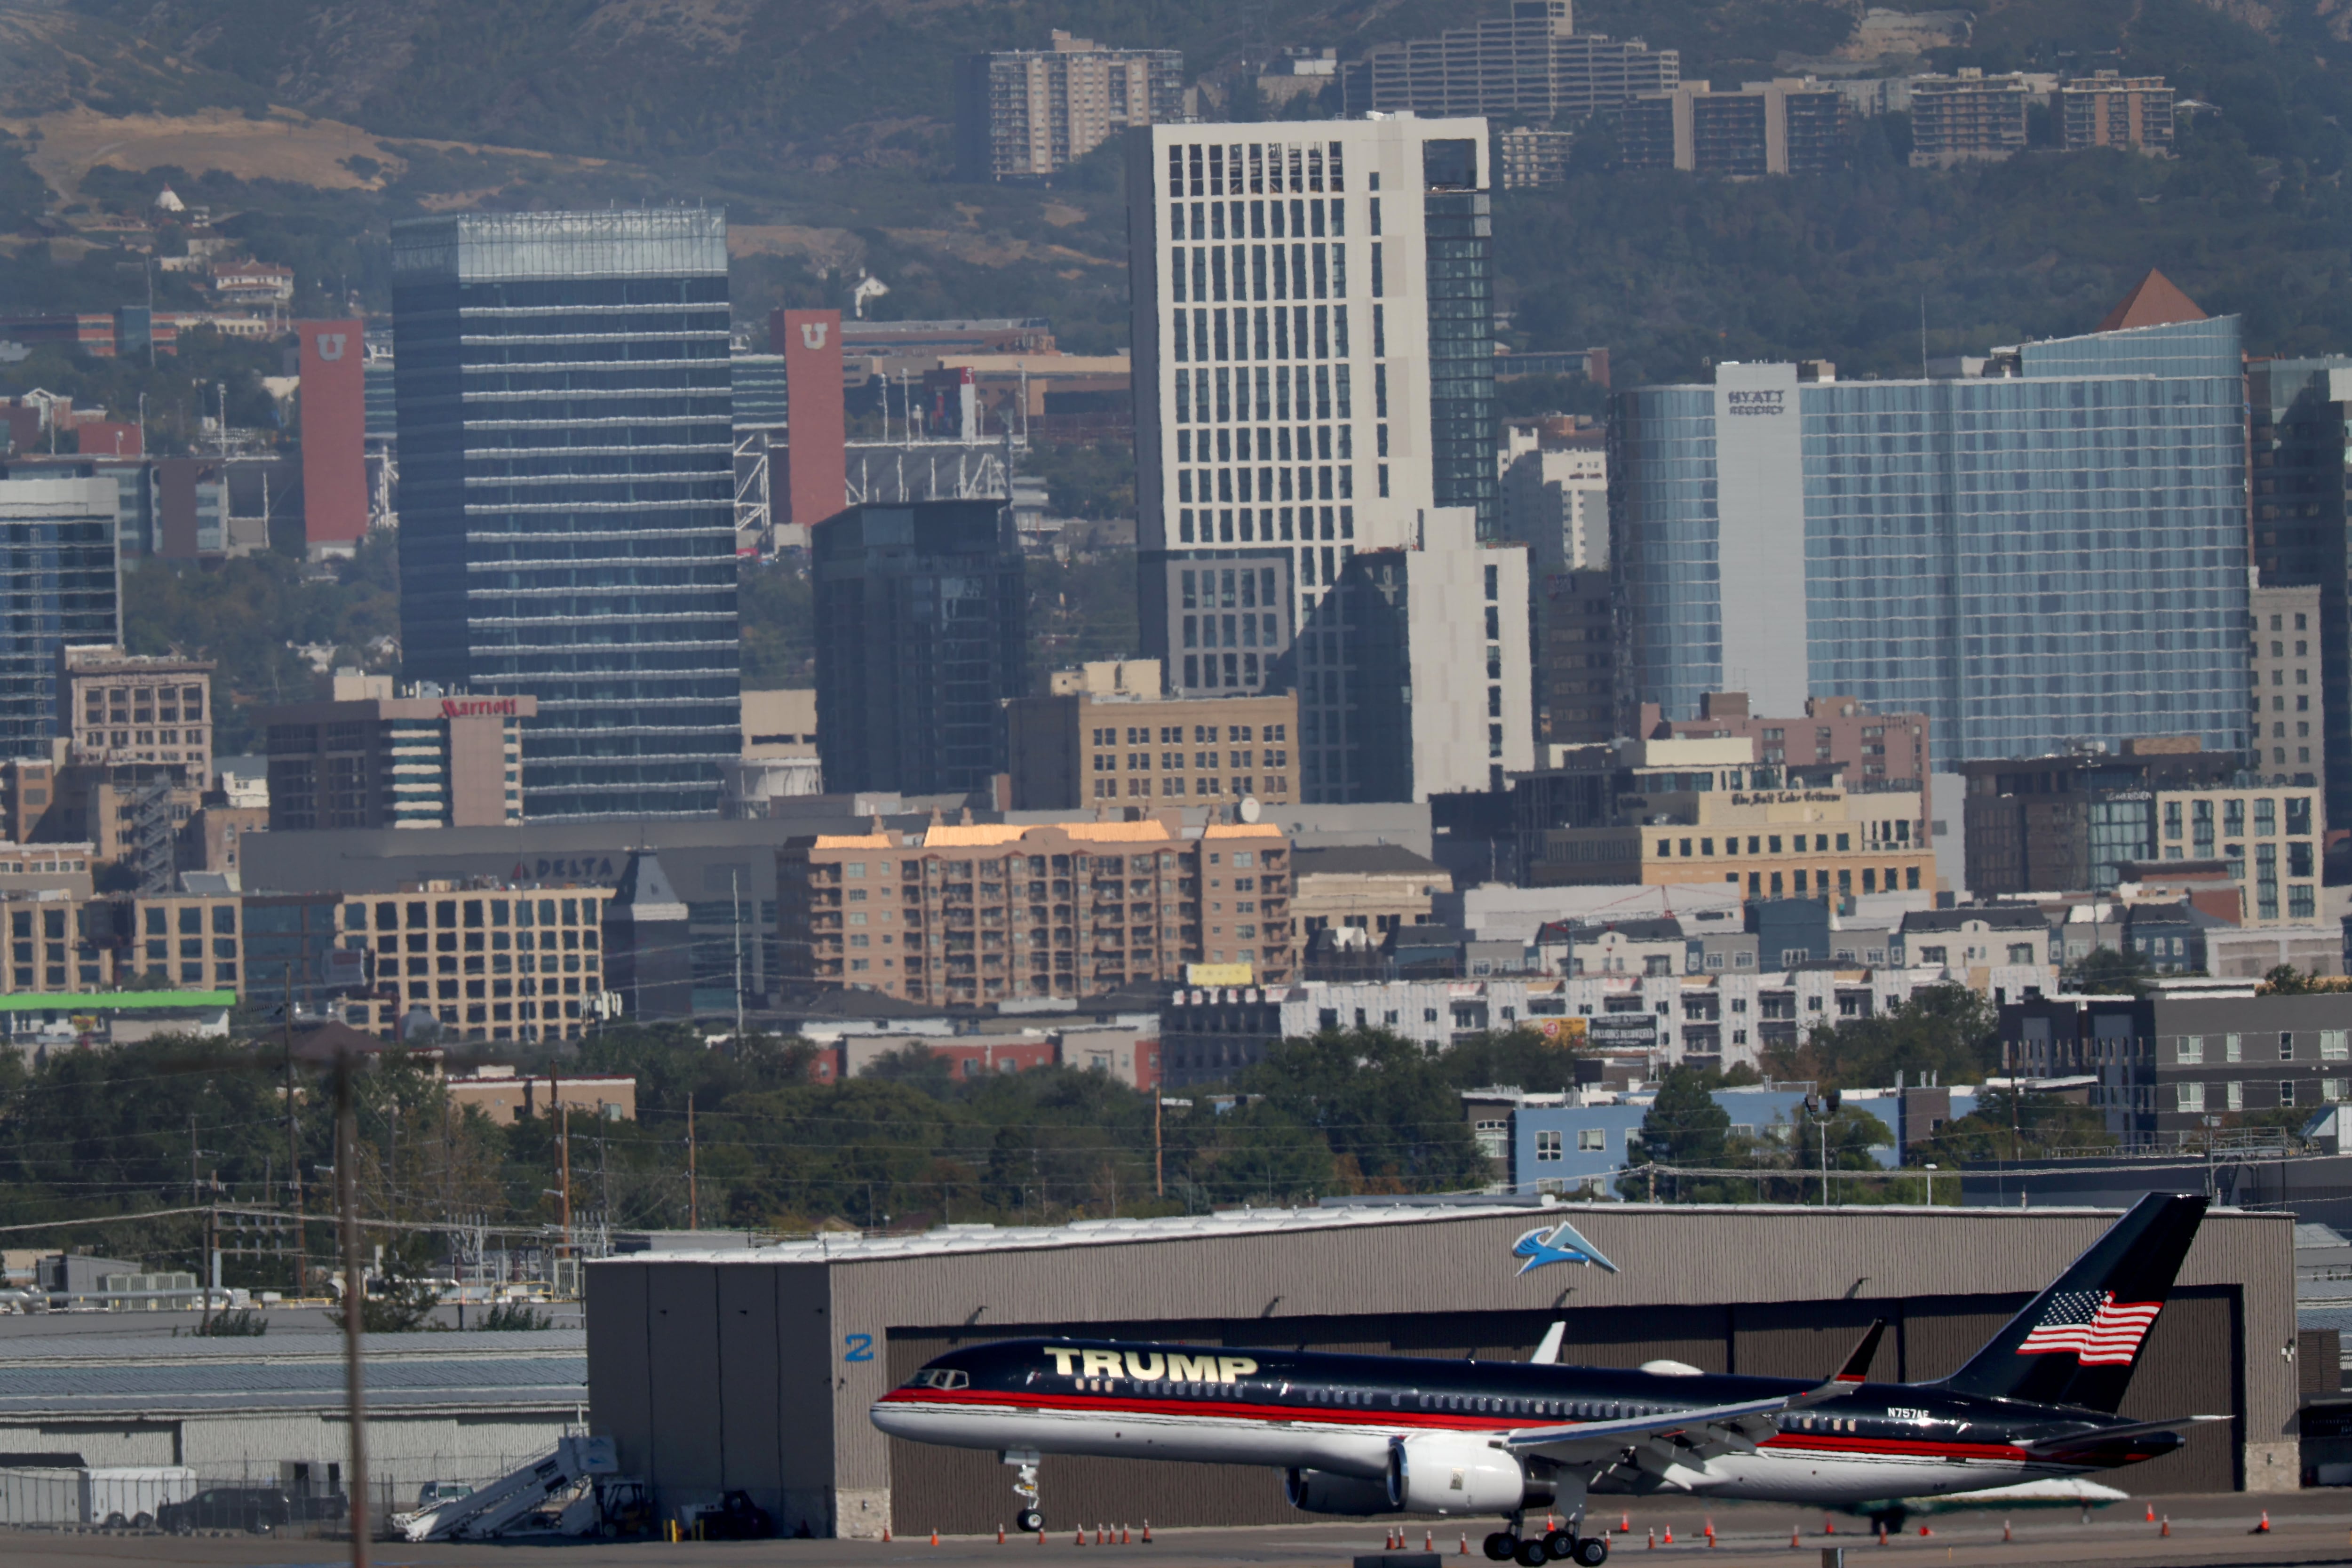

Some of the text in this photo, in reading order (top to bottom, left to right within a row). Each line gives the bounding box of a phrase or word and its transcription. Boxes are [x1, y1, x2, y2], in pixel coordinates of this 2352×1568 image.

[317, 334, 346, 361] U
[801, 323, 827, 350] U
[1728, 390, 1785, 404] HYATT
[438, 700, 516, 717] Marriott
[537, 857, 613, 878] DELTA
[845, 1333, 874, 1362] 2
[1044, 1346, 1258, 1384] TRUMP
